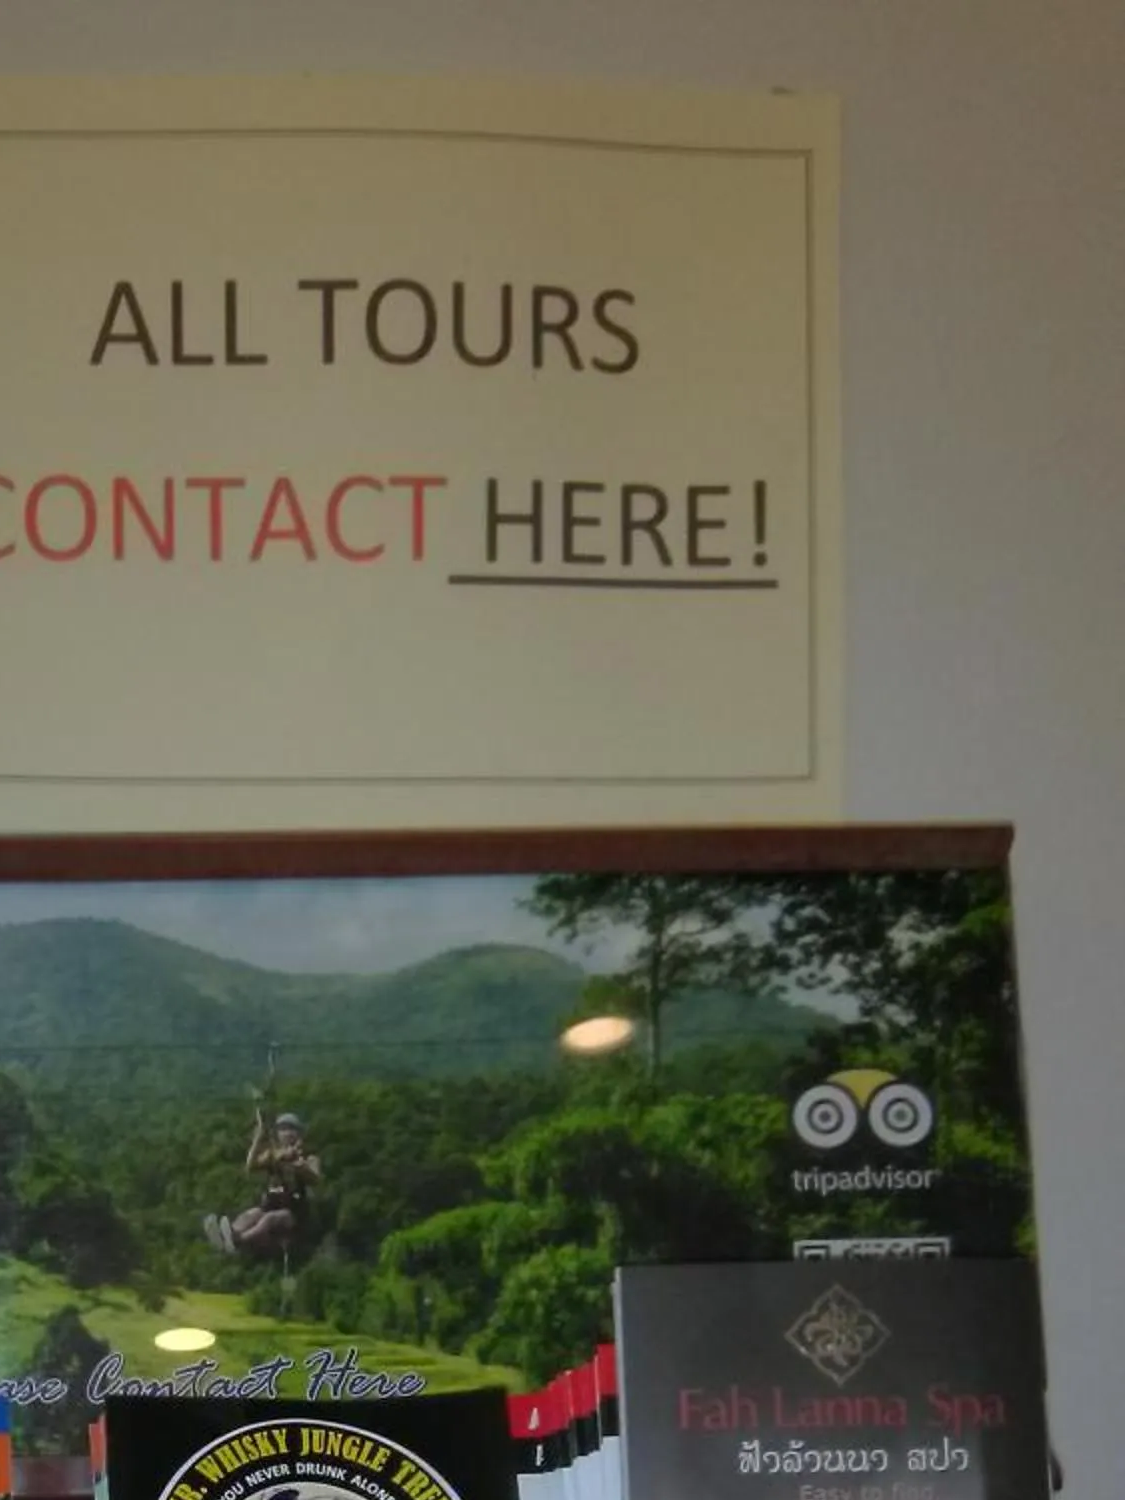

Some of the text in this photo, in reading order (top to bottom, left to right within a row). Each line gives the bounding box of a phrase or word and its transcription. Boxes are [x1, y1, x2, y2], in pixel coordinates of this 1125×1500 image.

[89, 279, 640, 375] ALL TOURS
[482, 477, 769, 569] HERE!
[791, 1165, 935, 1195] tripadvisor
[85, 1352, 297, 1402] Contact
[305, 1348, 427, 1400] Here
[678, 1384, 1009, 1434] Fah Lanna Spa
[195, 1428, 289, 1483] WHISKY
[300, 1427, 391, 1473] JUNGLE
[244, 1463, 291, 1487] NEVER
[296, 1461, 348, 1481] DRUNK
